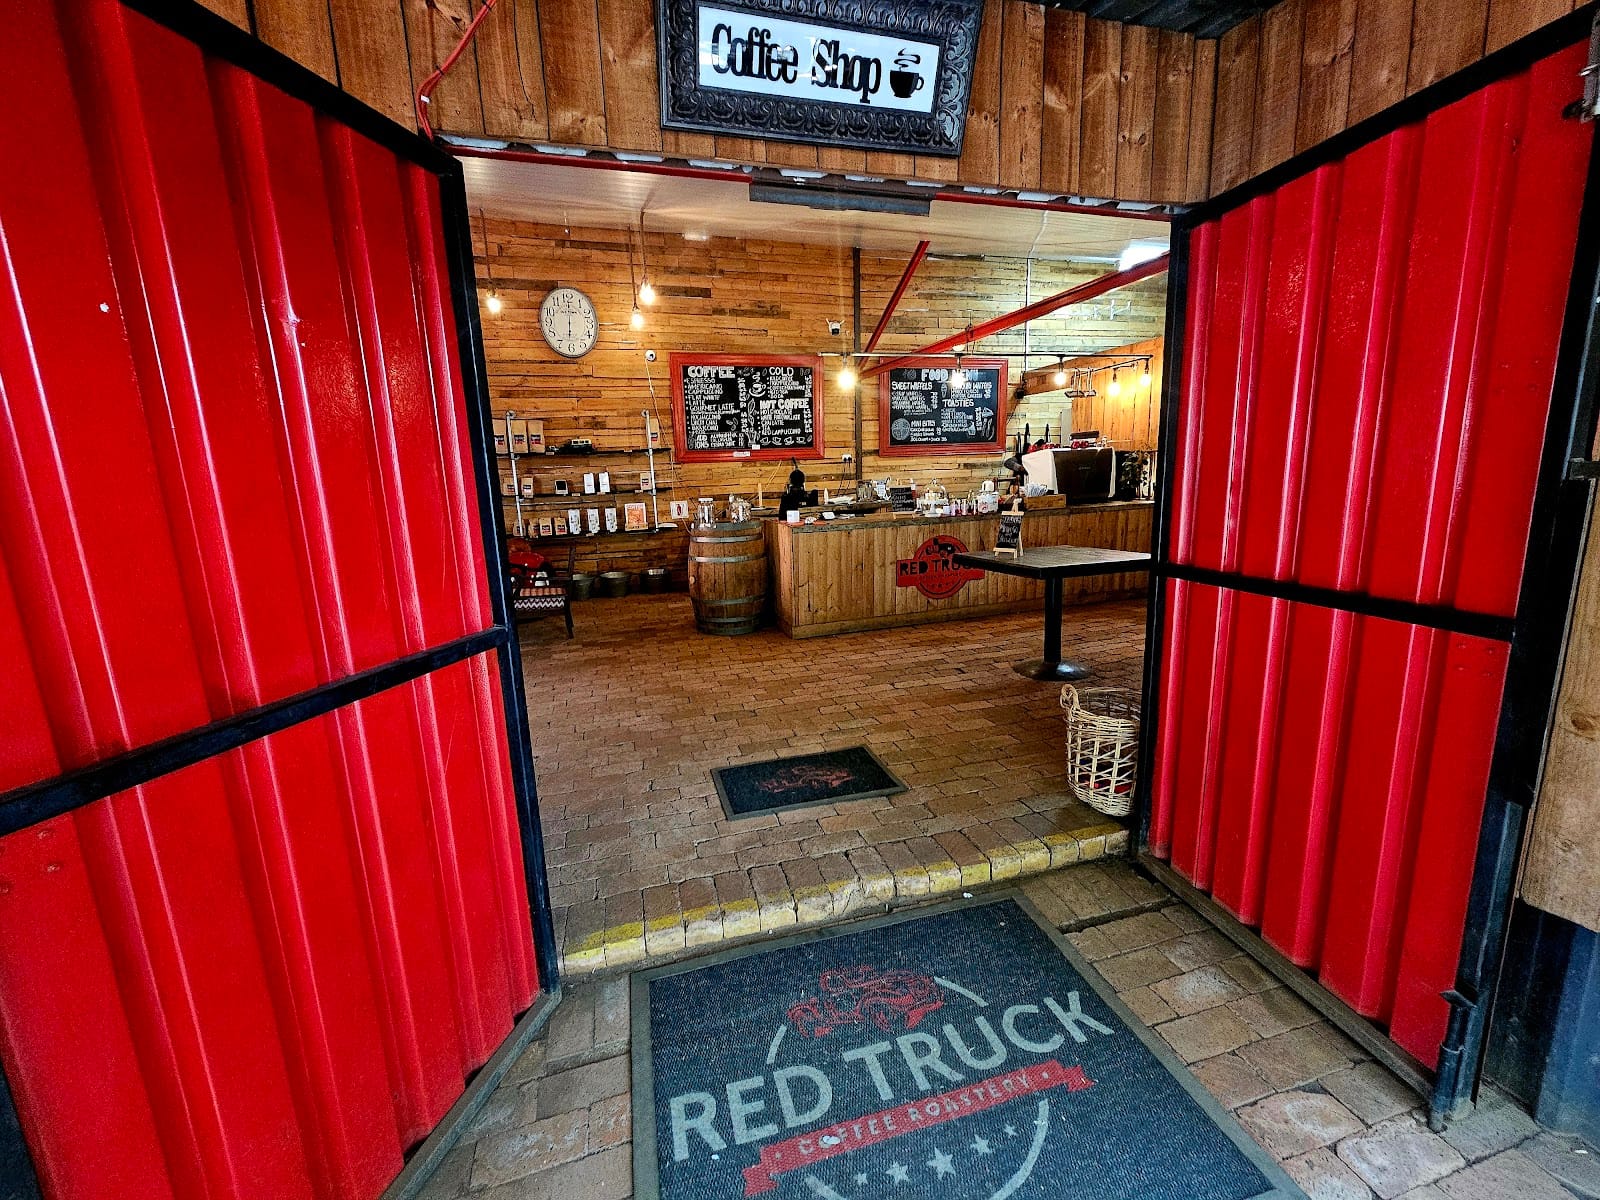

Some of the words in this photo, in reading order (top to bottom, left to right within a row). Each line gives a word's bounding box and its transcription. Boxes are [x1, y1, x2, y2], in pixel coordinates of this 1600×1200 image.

[711, 23, 798, 84] Coffee
[810, 38, 881, 104] Shop
[563, 293, 574, 303] 12
[544, 307, 555, 316] 10
[688, 366, 736, 378] COFFEE
[769, 366, 794, 377] COLD
[921, 368, 949, 382] FOOD
[891, 381, 911, 391] SWEET
[718, 402, 735, 411] LATTE
[777, 398, 809, 409] COFFEE
[942, 399, 975, 408] TOASTIES
[900, 560, 929, 576] RED
[669, 1063, 834, 1162] RED
[842, 990, 1114, 1101] TRUCK
[800, 1116, 897, 1155] COFFEE
[908, 1075, 1032, 1123] ROASTERY
